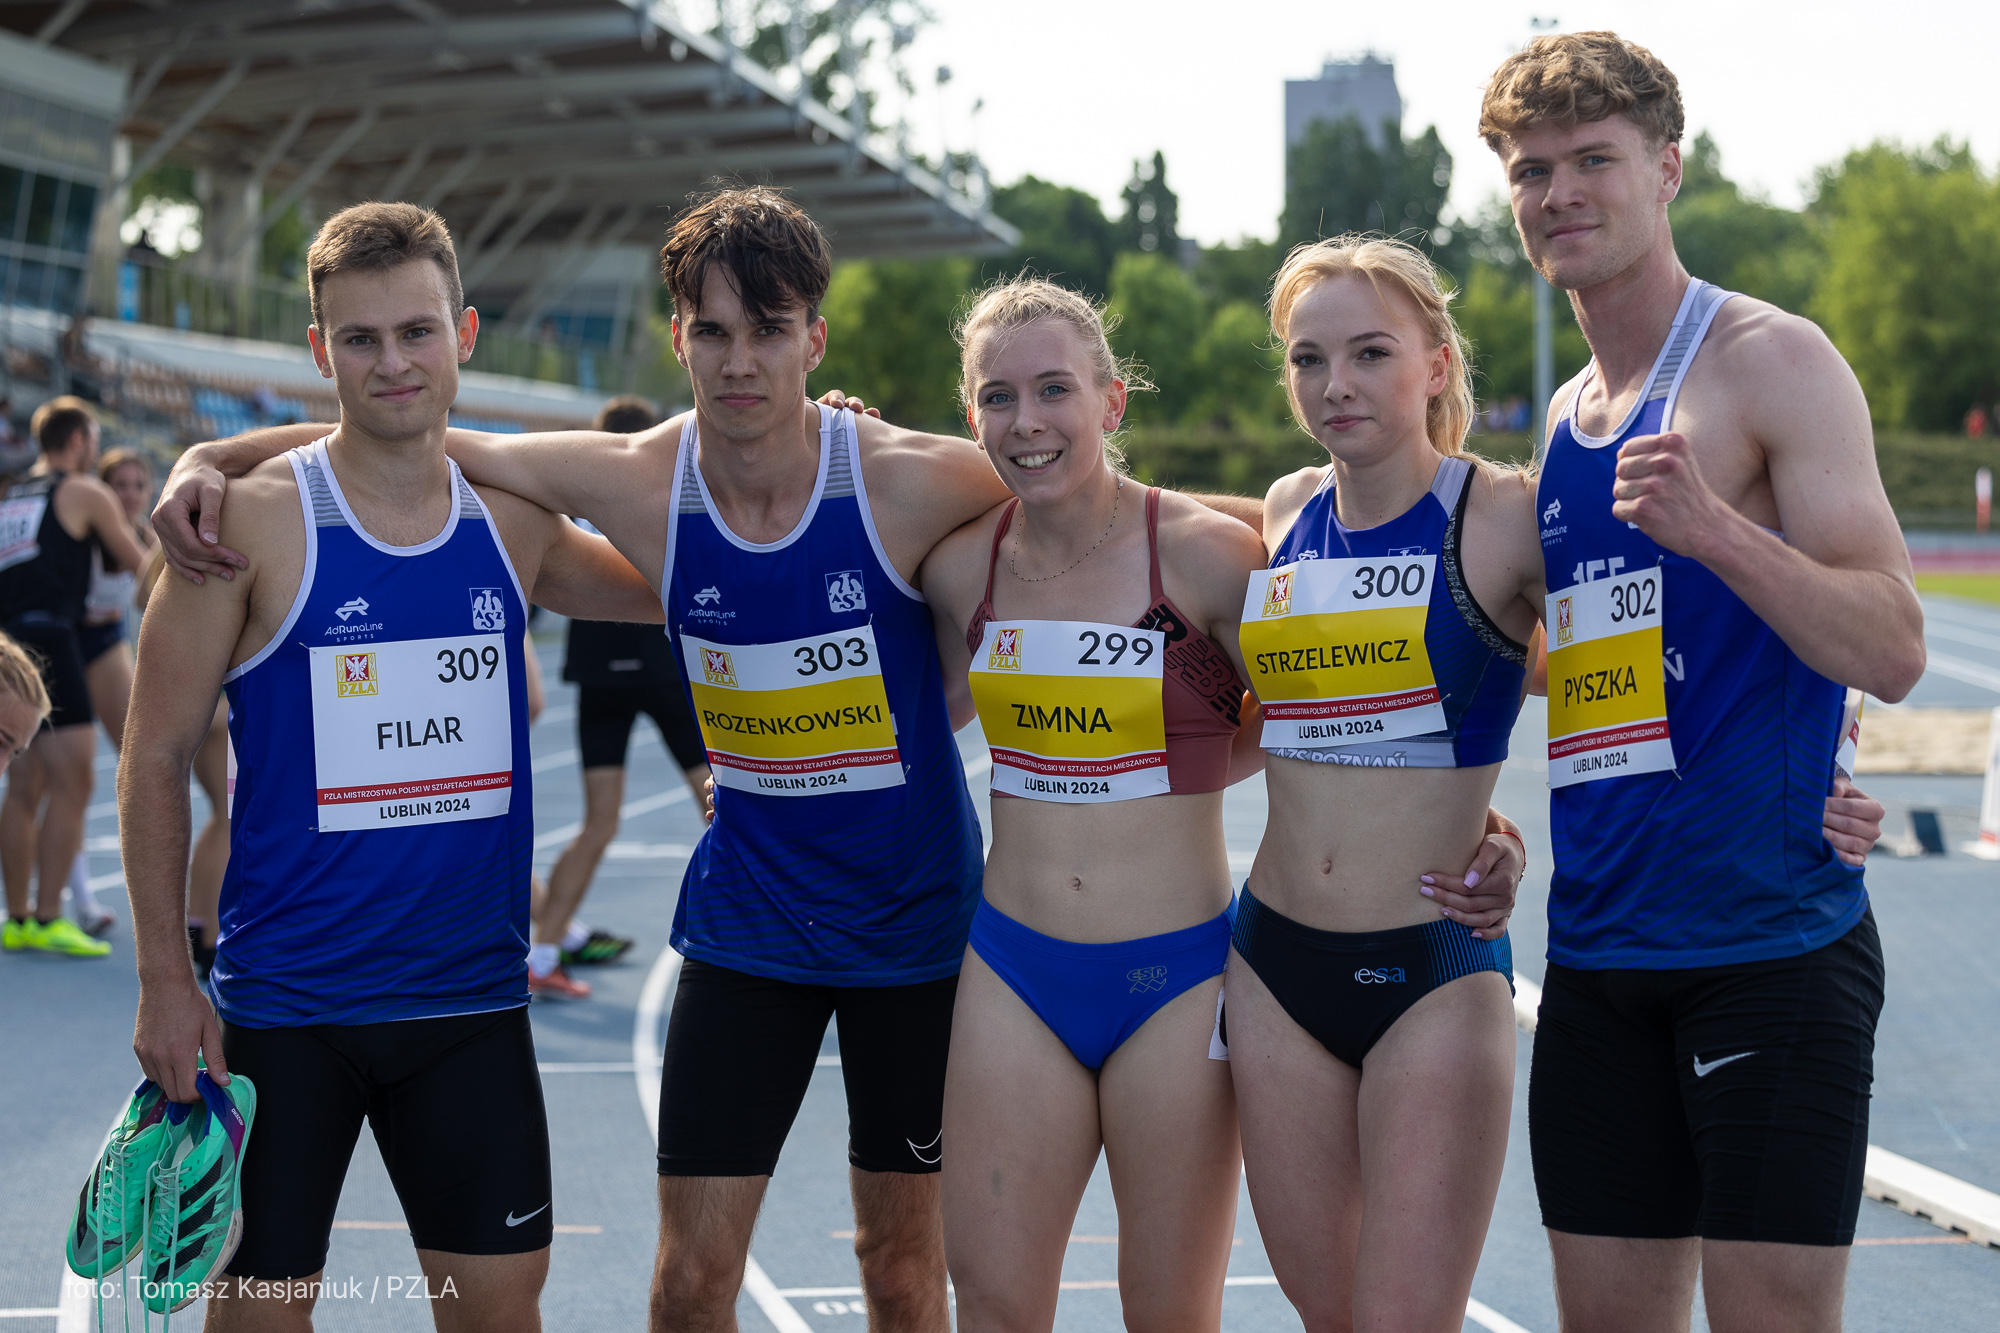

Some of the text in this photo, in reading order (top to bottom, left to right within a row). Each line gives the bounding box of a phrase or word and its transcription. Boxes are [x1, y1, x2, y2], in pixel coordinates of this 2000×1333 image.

[1352, 563, 1425, 600] 300
[1264, 602, 1289, 615] PZLA
[1610, 578, 1656, 622] 302
[336, 633, 374, 643] SPORTS
[1558, 628, 1572, 643] PZLA
[794, 637, 868, 676] 303
[1078, 631, 1153, 666] 299
[1256, 639, 1410, 675] STRZELEWICZ
[437, 646, 499, 683] 309
[990, 656, 1018, 669] PZLA
[340, 682, 376, 695] PZLA
[706, 672, 737, 686] PZLA
[1565, 665, 1637, 708] PYSZKA
[1310, 706, 1330, 715] POLSKI
[1339, 701, 1384, 713] SZTAFETACH
[1384, 692, 1434, 708] MIESZANYCH
[703, 704, 882, 735] ROZENKOWSKI
[1011, 703, 1113, 733] ZIMNA
[1299, 719, 1384, 739] LUBLIN 2024
[377, 716, 463, 750] FILAR
[1581, 738, 1596, 747] POLSKI
[1602, 731, 1630, 744] SZTAFETACH
[1630, 726, 1664, 738] MIESZANYCH
[713, 755, 728, 764] PZLA
[728, 758, 770, 770] MISTRZOSTWA
[771, 763, 794, 771] POLSKI
[803, 757, 848, 769] SZTAFETACH
[848, 753, 894, 764] MIESZANYCH
[1007, 755, 1037, 769] MISTRZOSTWA
[1037, 763, 1058, 772] POLSKI
[1067, 765, 1112, 773] SZTAFETACH
[1113, 756, 1161, 770] MIESZANYCH
[1573, 751, 1628, 774] LUBLIN 2024
[344, 789, 397, 799] MISTRZOSTWA
[399, 786, 422, 795] POLSKI
[432, 780, 473, 791] SZTAFETACH
[473, 776, 509, 787] MIESZANYCH
[757, 772, 847, 789] LUBLIN 2024
[1024, 777, 1110, 794] LUBLIN 2024
[379, 798, 470, 819] LUBLIN 2024
